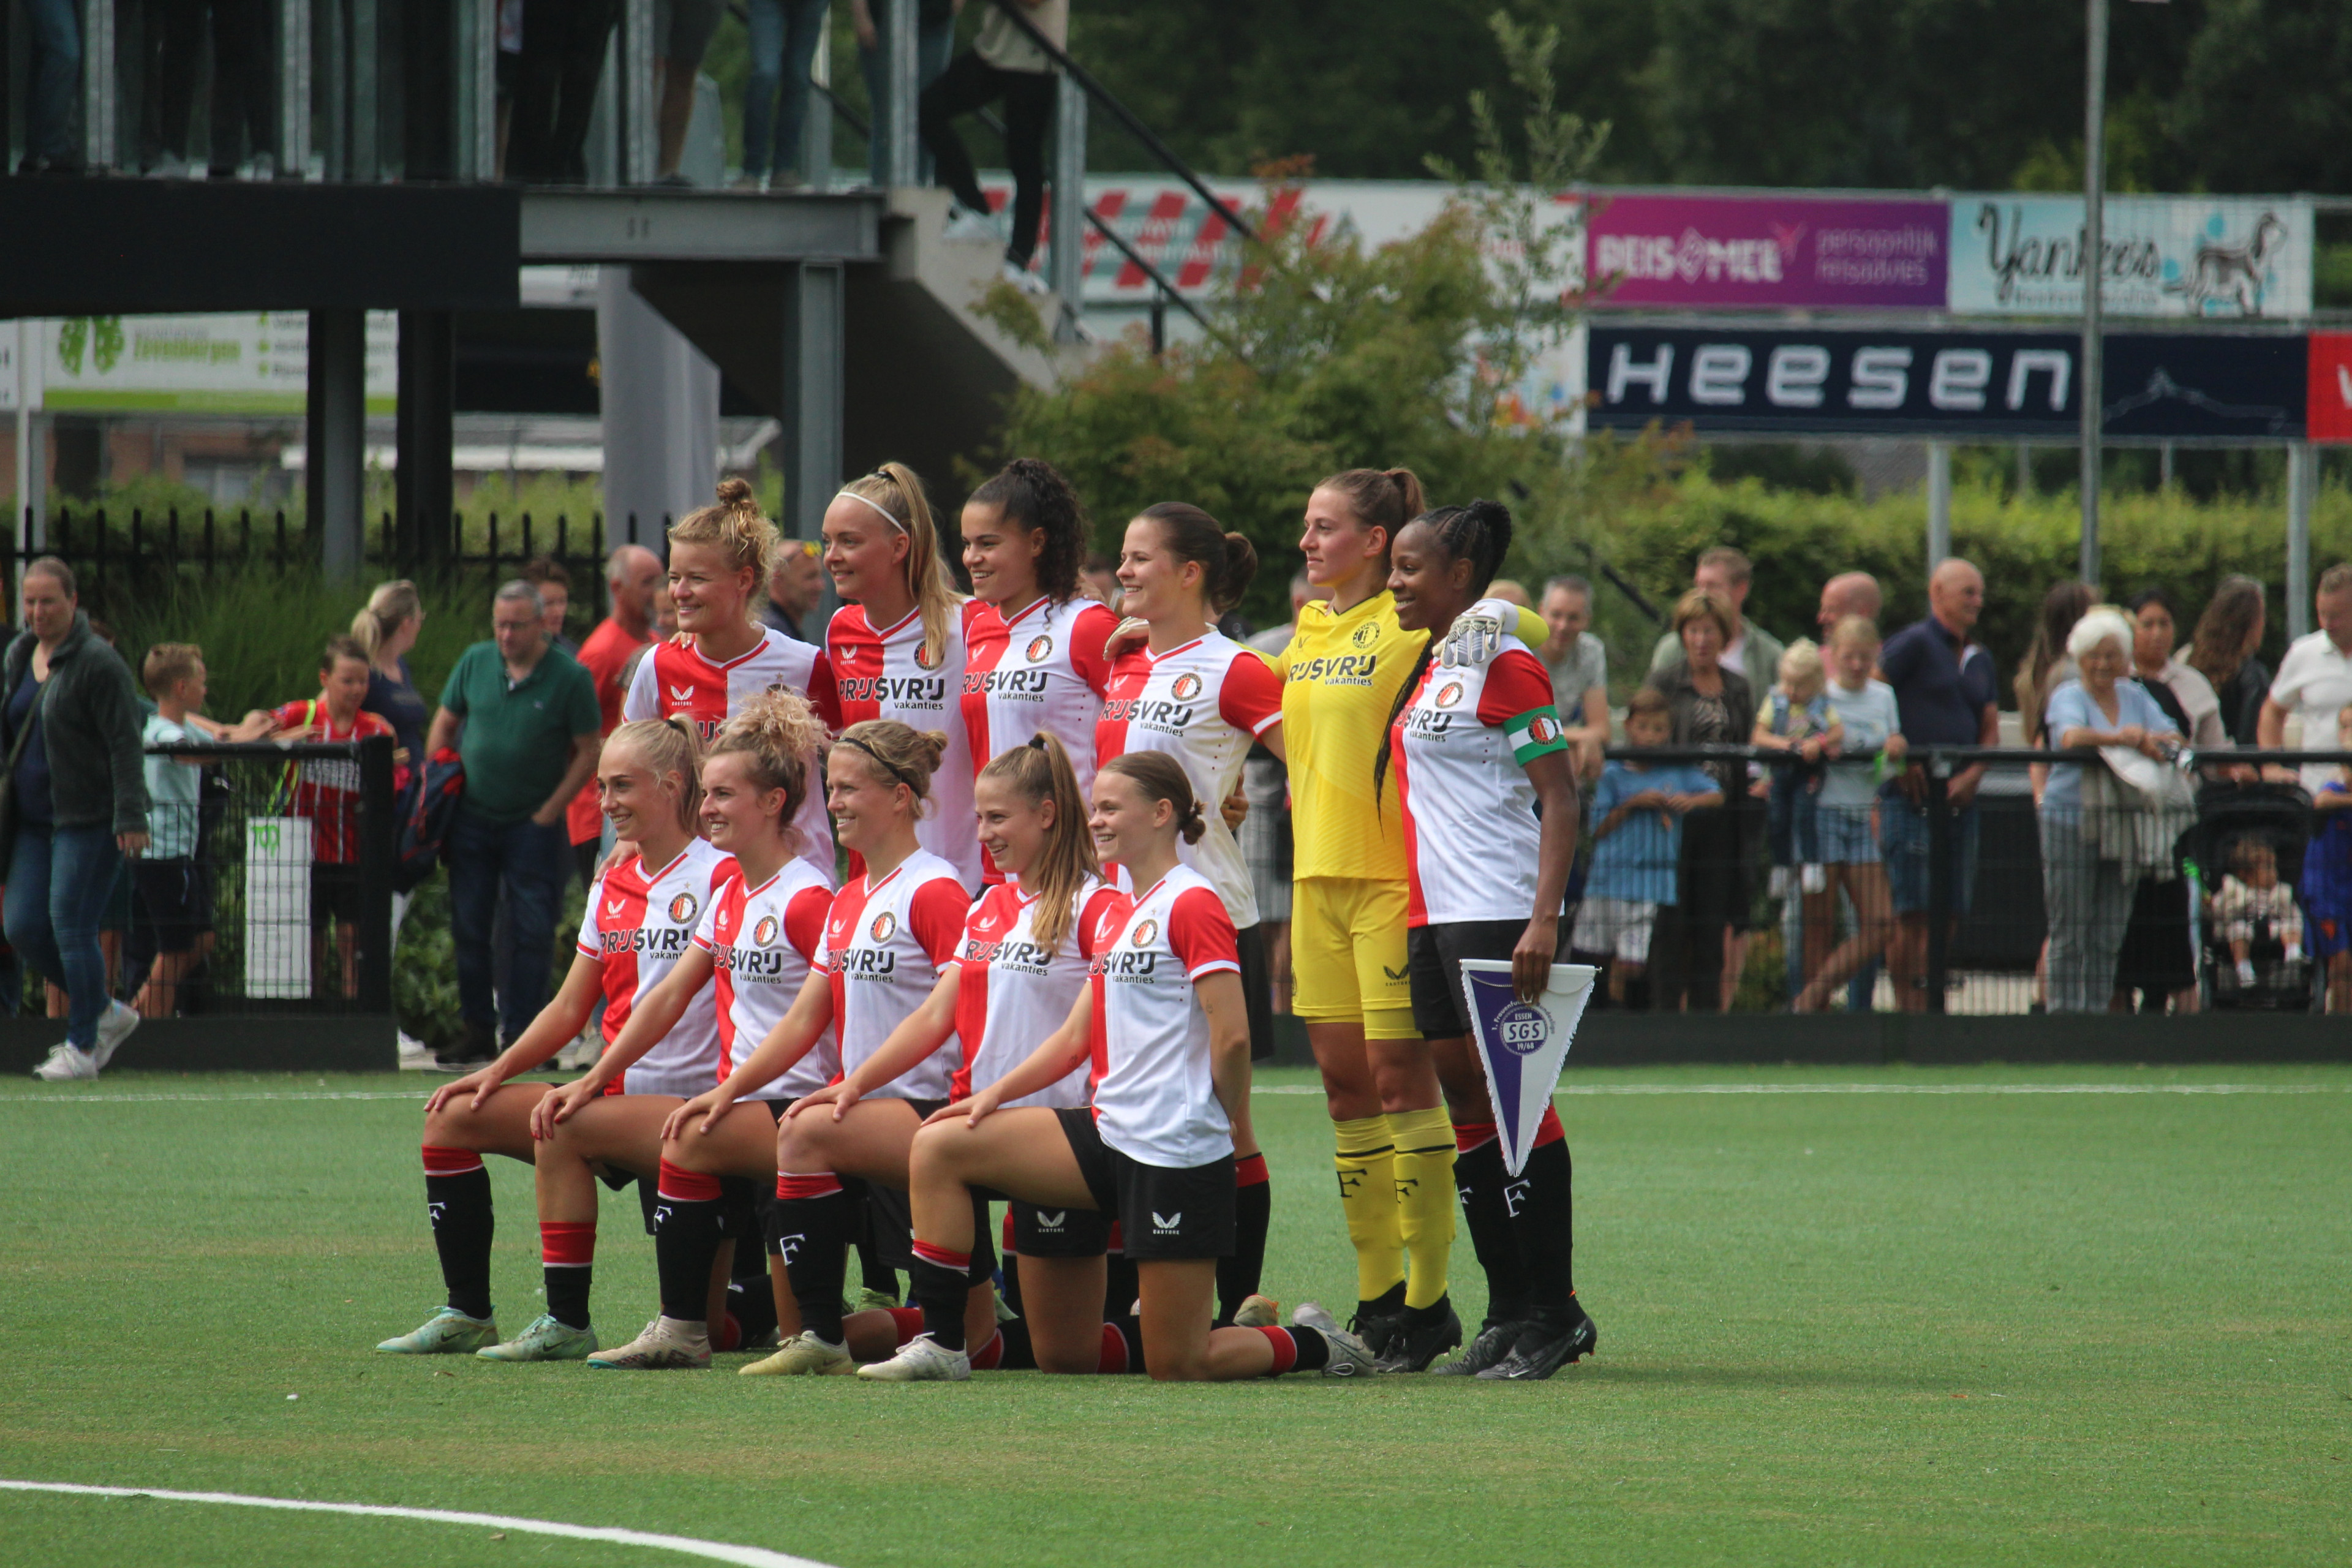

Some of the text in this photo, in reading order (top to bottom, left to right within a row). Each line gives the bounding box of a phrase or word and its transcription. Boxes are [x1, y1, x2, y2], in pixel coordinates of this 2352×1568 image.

[1325, 676, 1373, 687] vakanties
[998, 692, 1044, 703] vakanties
[894, 700, 944, 710] vakanties
[1140, 720, 1184, 737] vakanties
[1001, 962, 1049, 977] vakanties
[739, 972, 782, 985] vakanties
[851, 972, 894, 984] vakanties
[1112, 974, 1155, 984] vakanties
[1515, 1012, 1532, 1021] ESSEN
[1509, 1022, 1540, 1041] SGS
[1517, 1042, 1535, 1051] 19/68
